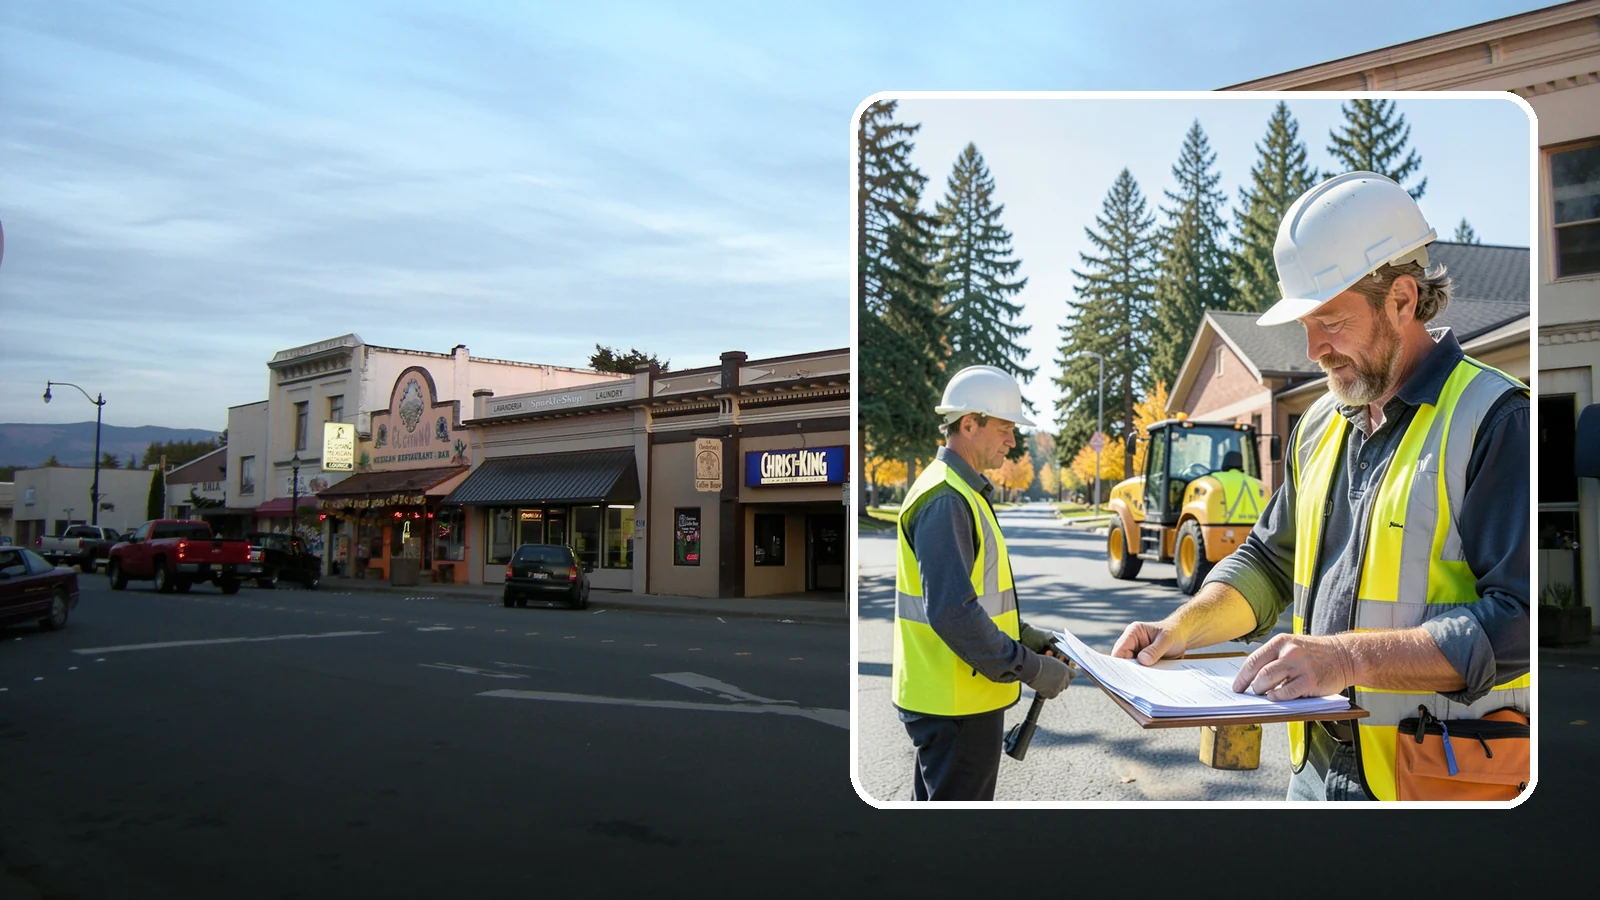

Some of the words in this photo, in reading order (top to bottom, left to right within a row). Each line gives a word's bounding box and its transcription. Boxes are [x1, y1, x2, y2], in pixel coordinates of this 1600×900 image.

[493, 402, 522, 412] LAVANDERIA
[595, 389, 623, 400] LAUNDRY
[373, 455, 396, 464] MEXICAN
[397, 451, 433, 462] RESTAURANT
[438, 450, 450, 459] BAR
[761, 452, 797, 478] CHRIST
[799, 450, 827, 476] KING
